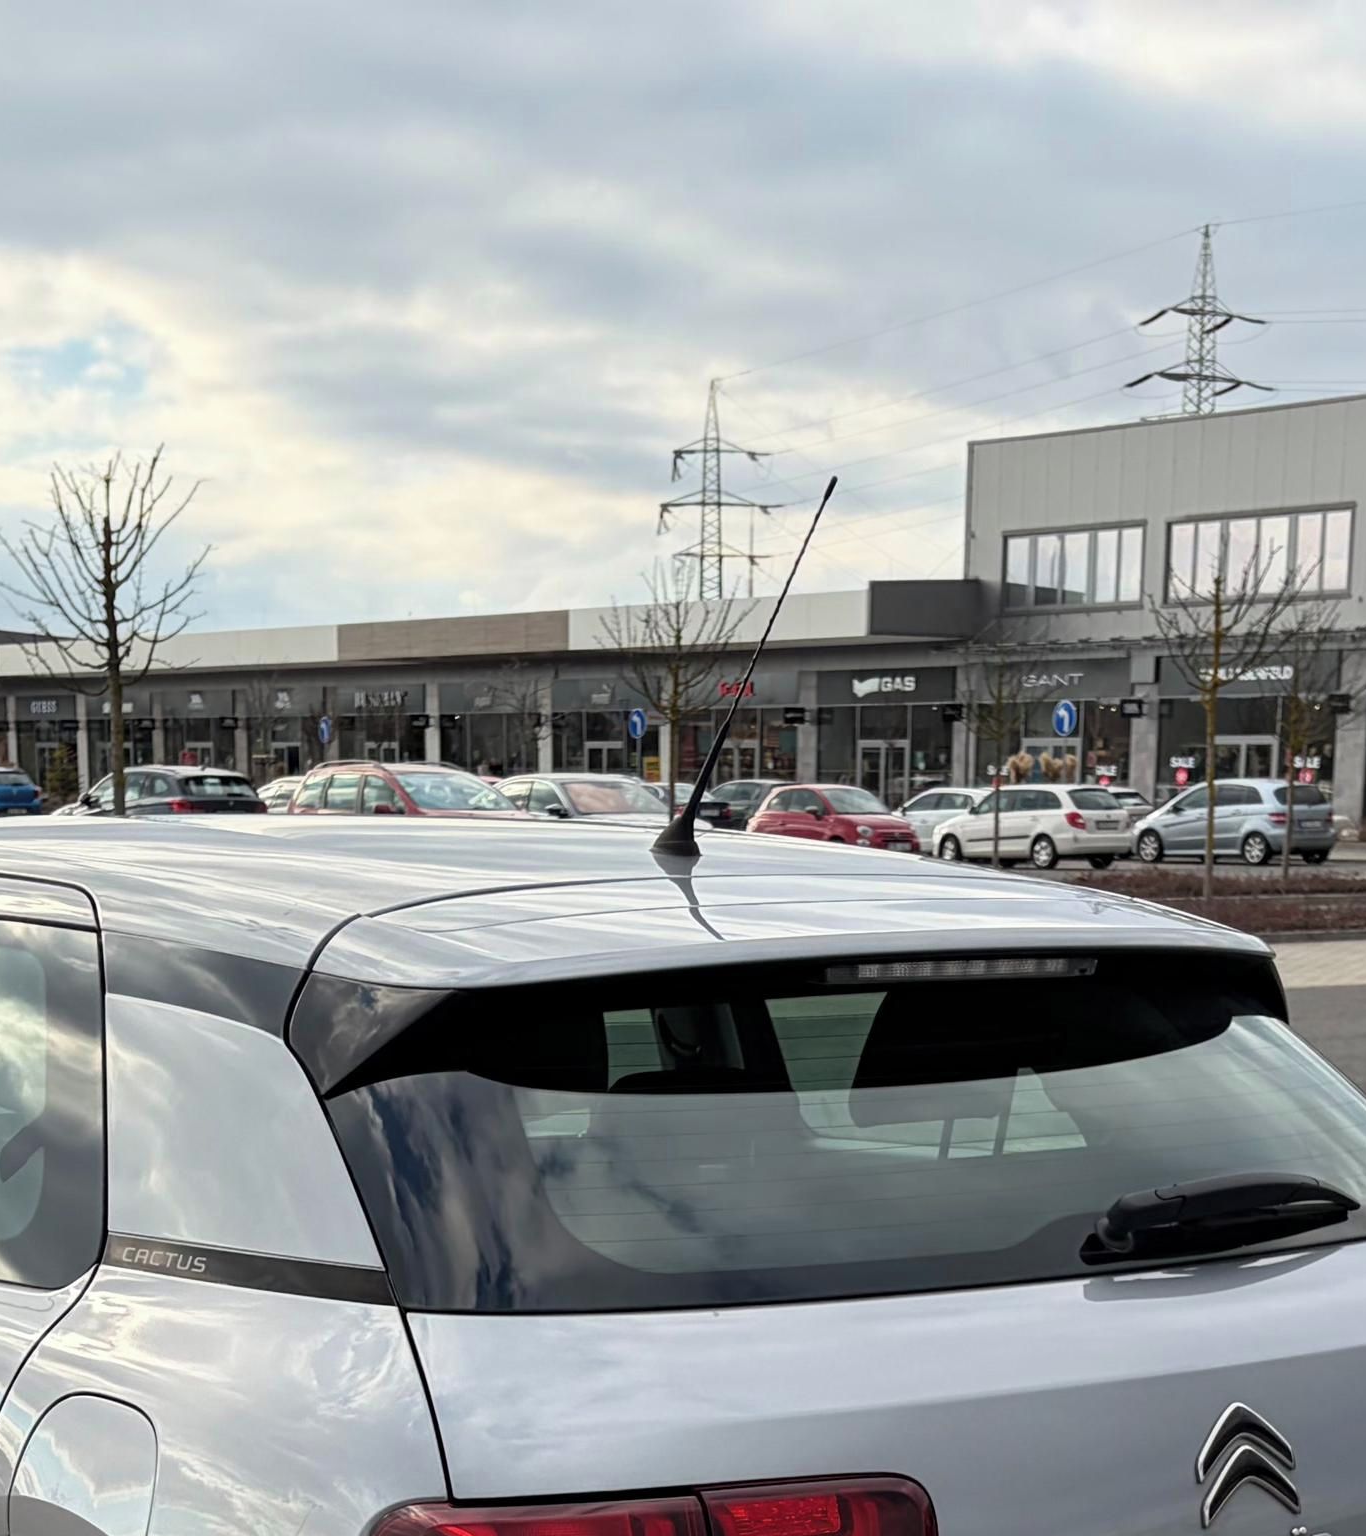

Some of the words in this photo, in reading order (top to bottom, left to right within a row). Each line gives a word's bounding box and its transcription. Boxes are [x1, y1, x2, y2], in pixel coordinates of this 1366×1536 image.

[880, 676, 917, 693] GAS
[1021, 672, 1084, 688] GANT
[1169, 756, 1195, 768] SALE
[122, 1247, 207, 1273] CACTUS
